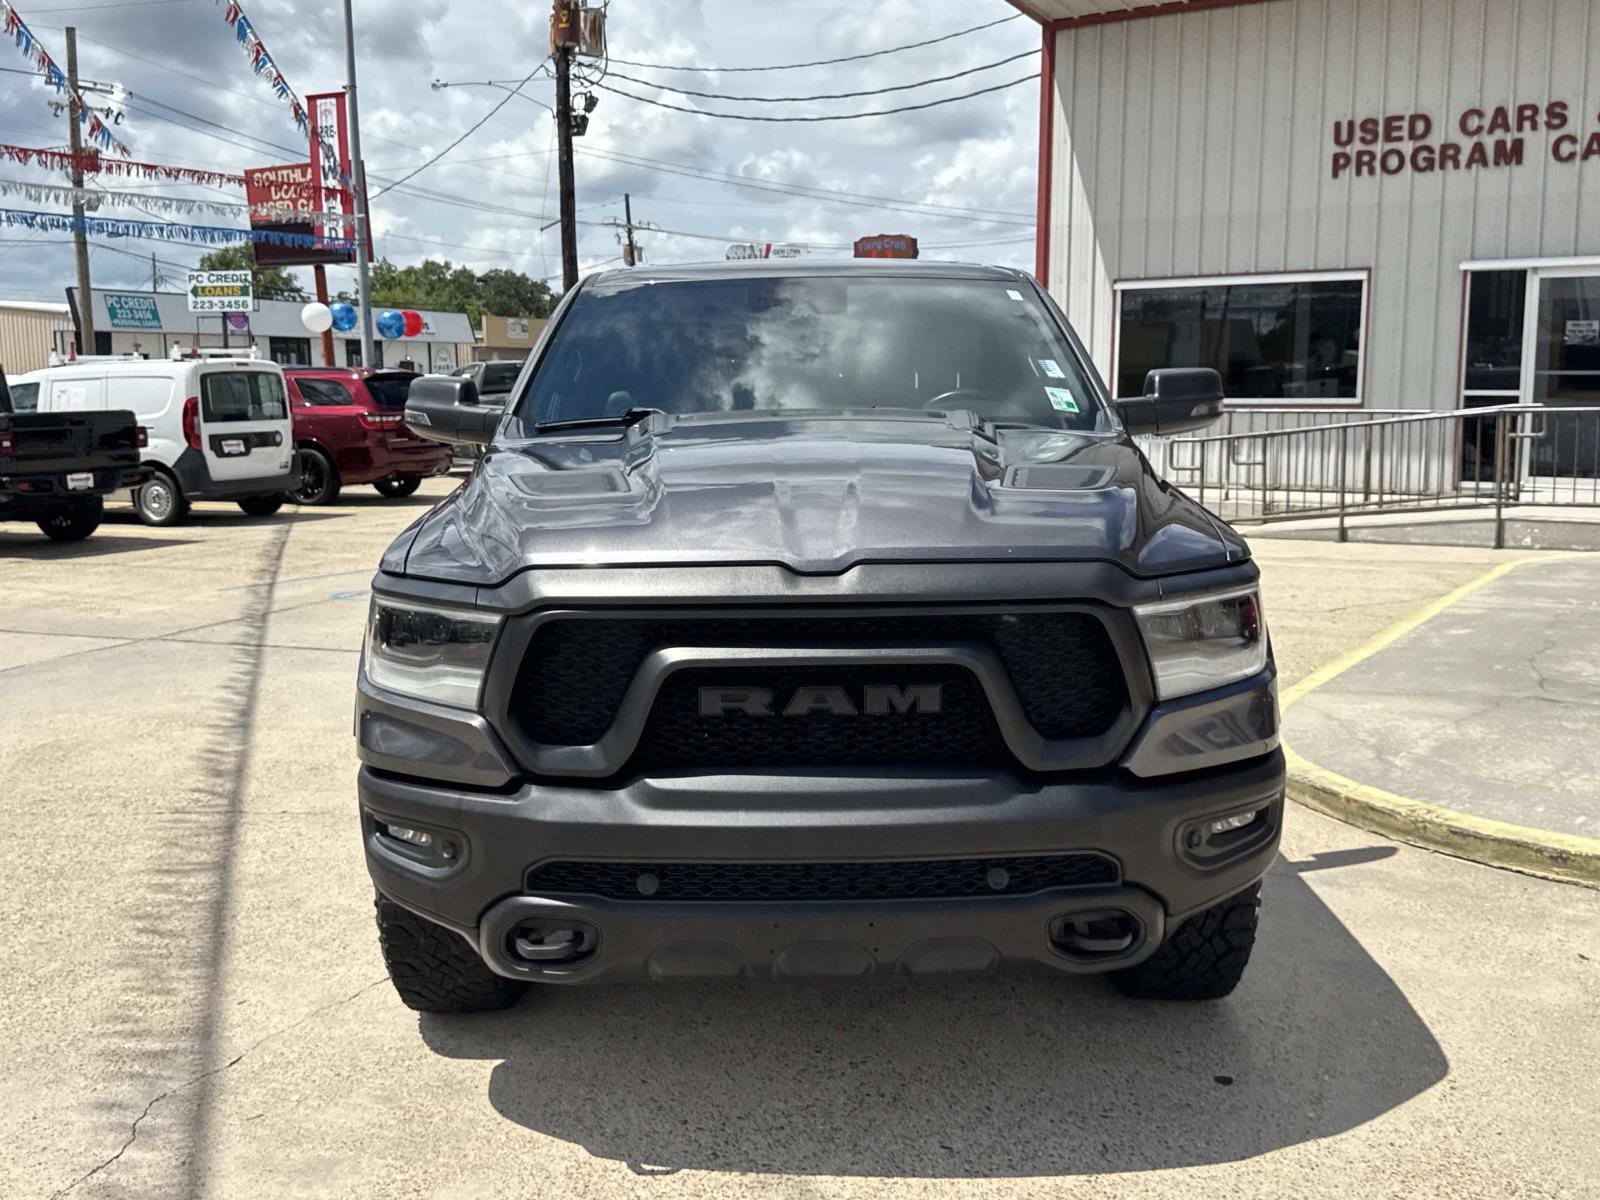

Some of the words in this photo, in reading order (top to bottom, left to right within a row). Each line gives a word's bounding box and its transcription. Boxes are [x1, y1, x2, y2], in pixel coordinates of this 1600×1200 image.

[1333, 113, 1432, 147] USED
[1458, 101, 1569, 137] CARS
[1331, 138, 1524, 179] PROGRAM
[188, 274, 204, 284] PC
[207, 273, 249, 284] CREDIT
[198, 286, 241, 296] LOANS
[106, 296, 120, 308] PC
[121, 297, 156, 310] CREDIT
[698, 684, 943, 716] RAM
